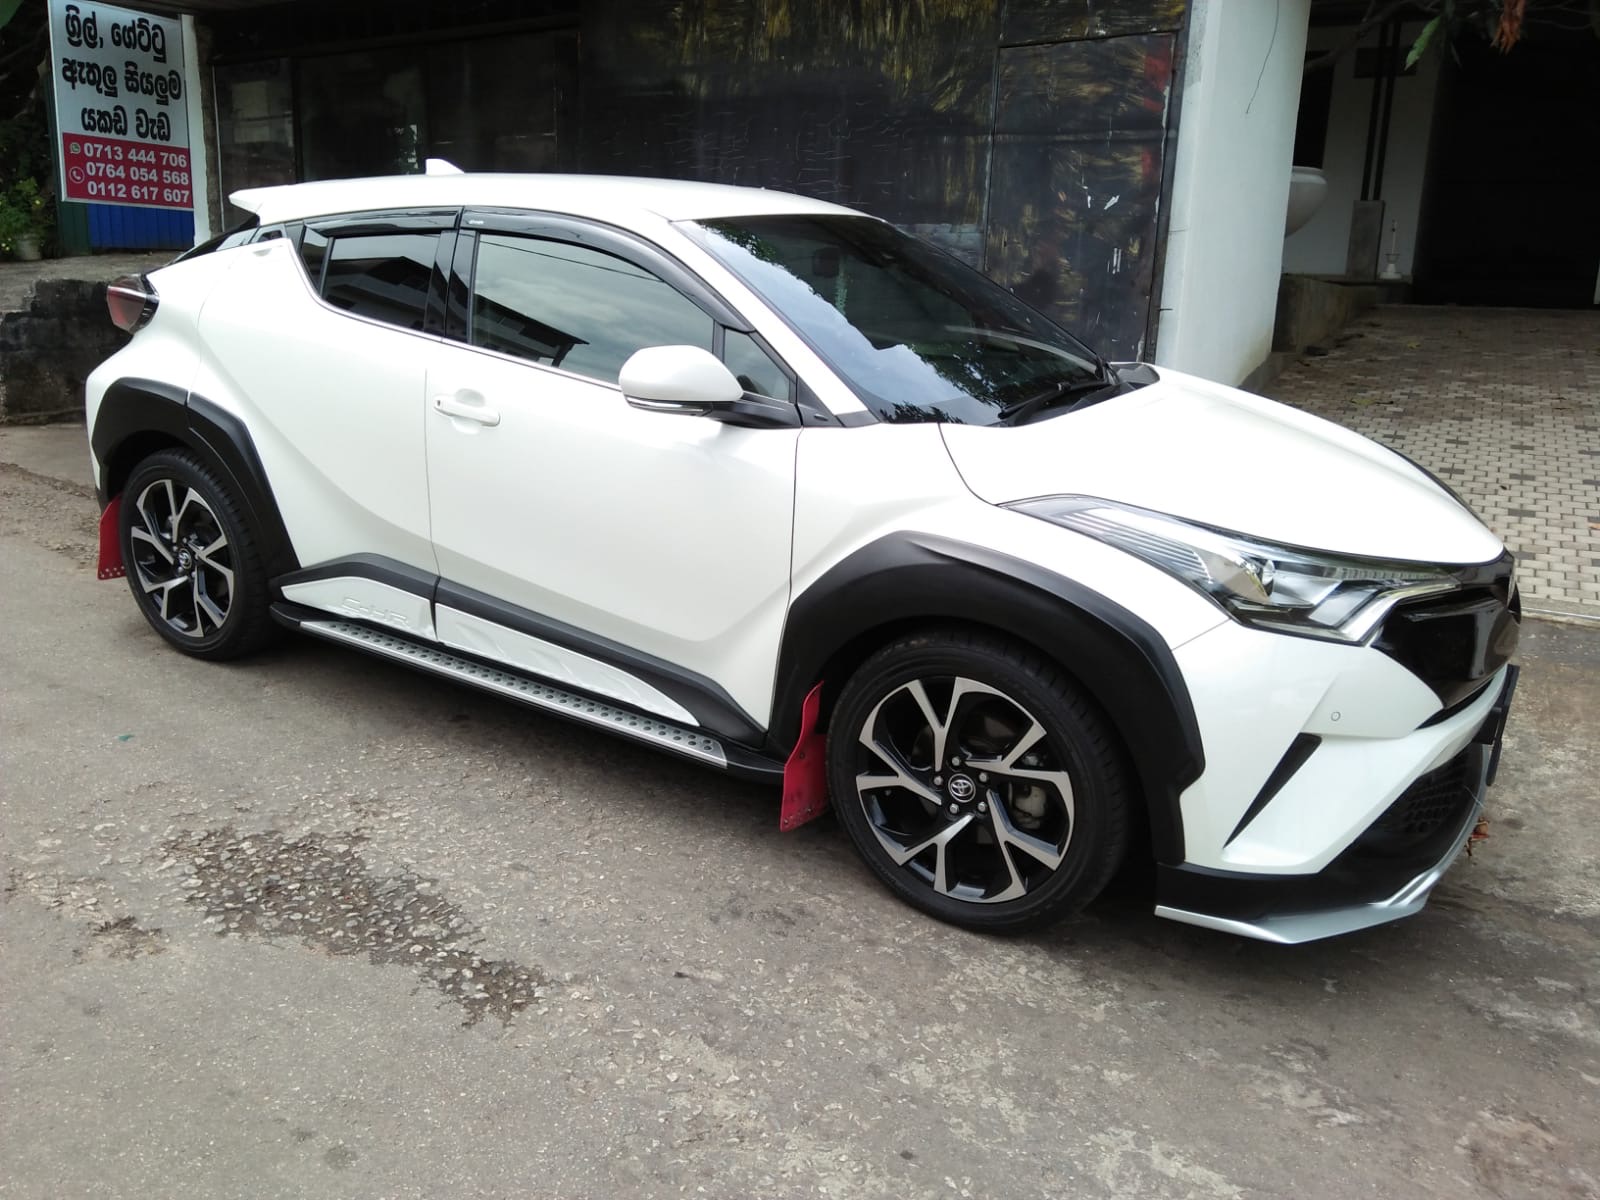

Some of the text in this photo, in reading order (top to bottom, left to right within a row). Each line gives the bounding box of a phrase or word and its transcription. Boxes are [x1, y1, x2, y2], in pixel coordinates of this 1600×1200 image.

[111, 18, 167, 64] ගේට්ටු
[124, 60, 182, 106] සියලුම
[81, 105, 171, 142] යකඩ වැඩ
[83, 143, 187, 168] 0713 444 706
[86, 162, 189, 186] 0764 054 568
[87, 181, 189, 203] 0112 617 607
